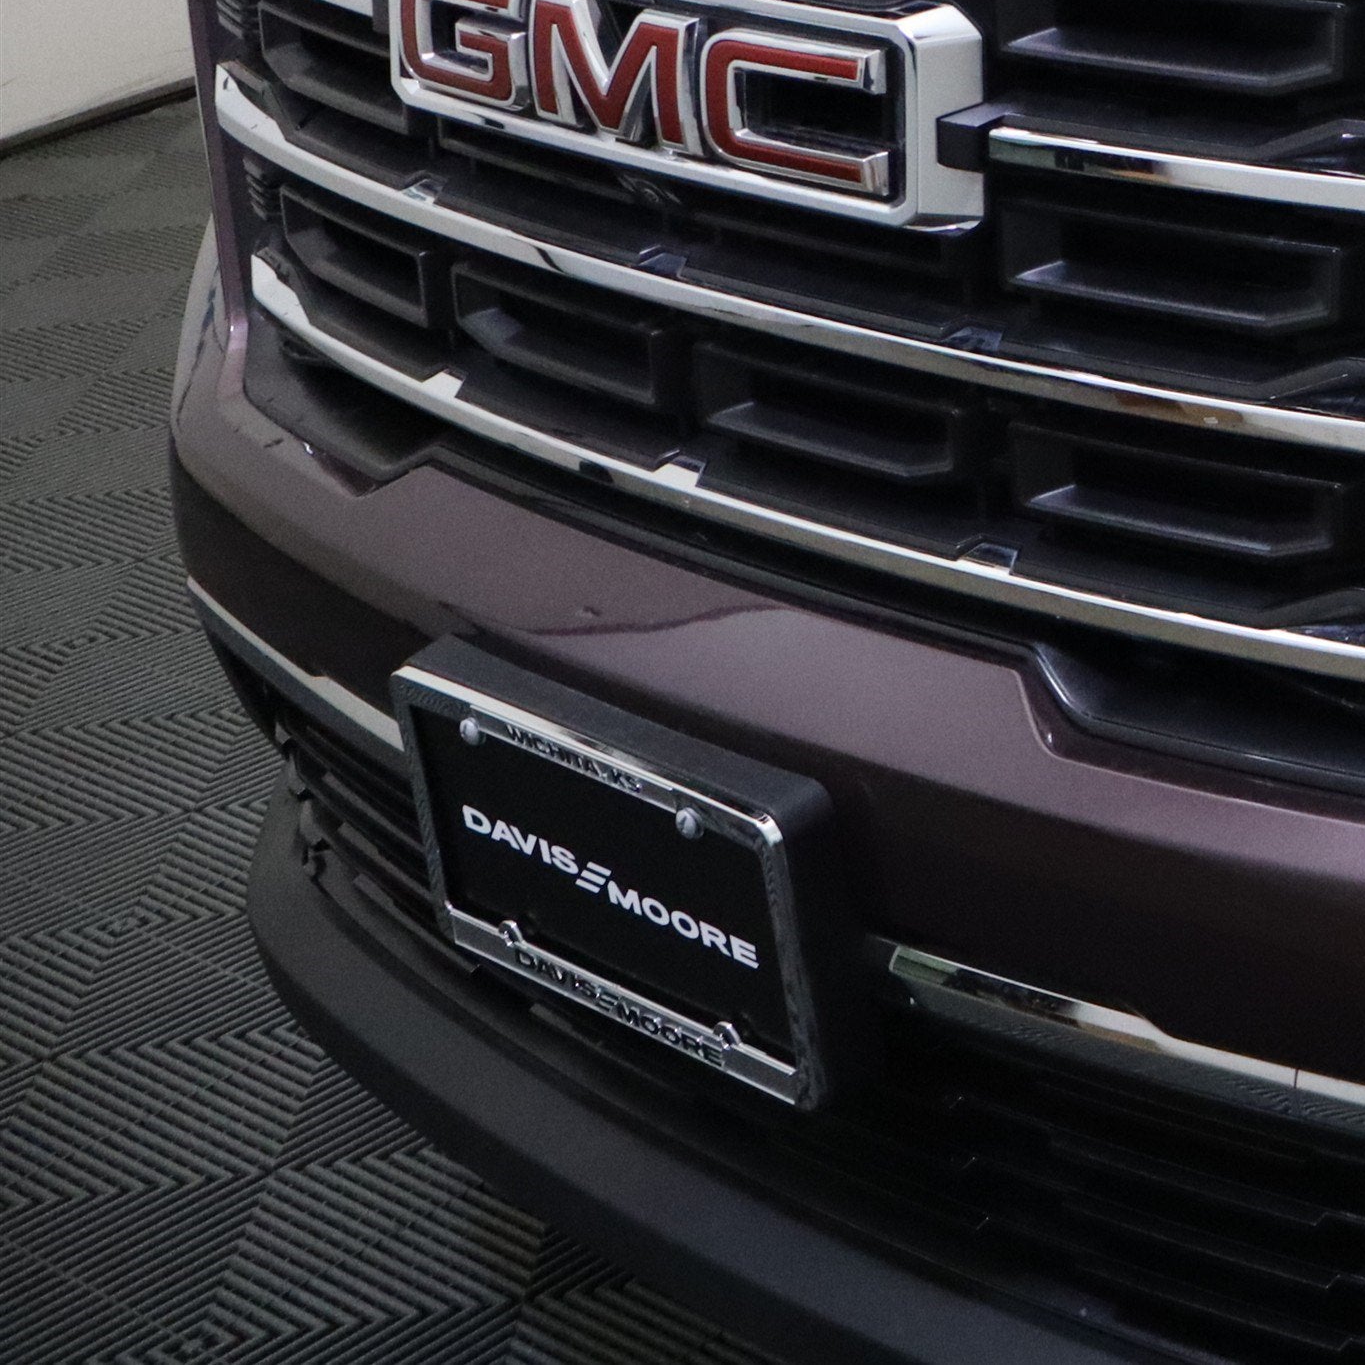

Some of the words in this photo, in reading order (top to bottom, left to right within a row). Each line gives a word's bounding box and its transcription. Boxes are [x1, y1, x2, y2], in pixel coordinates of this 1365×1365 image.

[462, 804, 579, 875] DAVIS
[607, 880, 760, 969] MOORE
[514, 947, 601, 998] DAVIS
[616, 995, 725, 1068] MOORE
